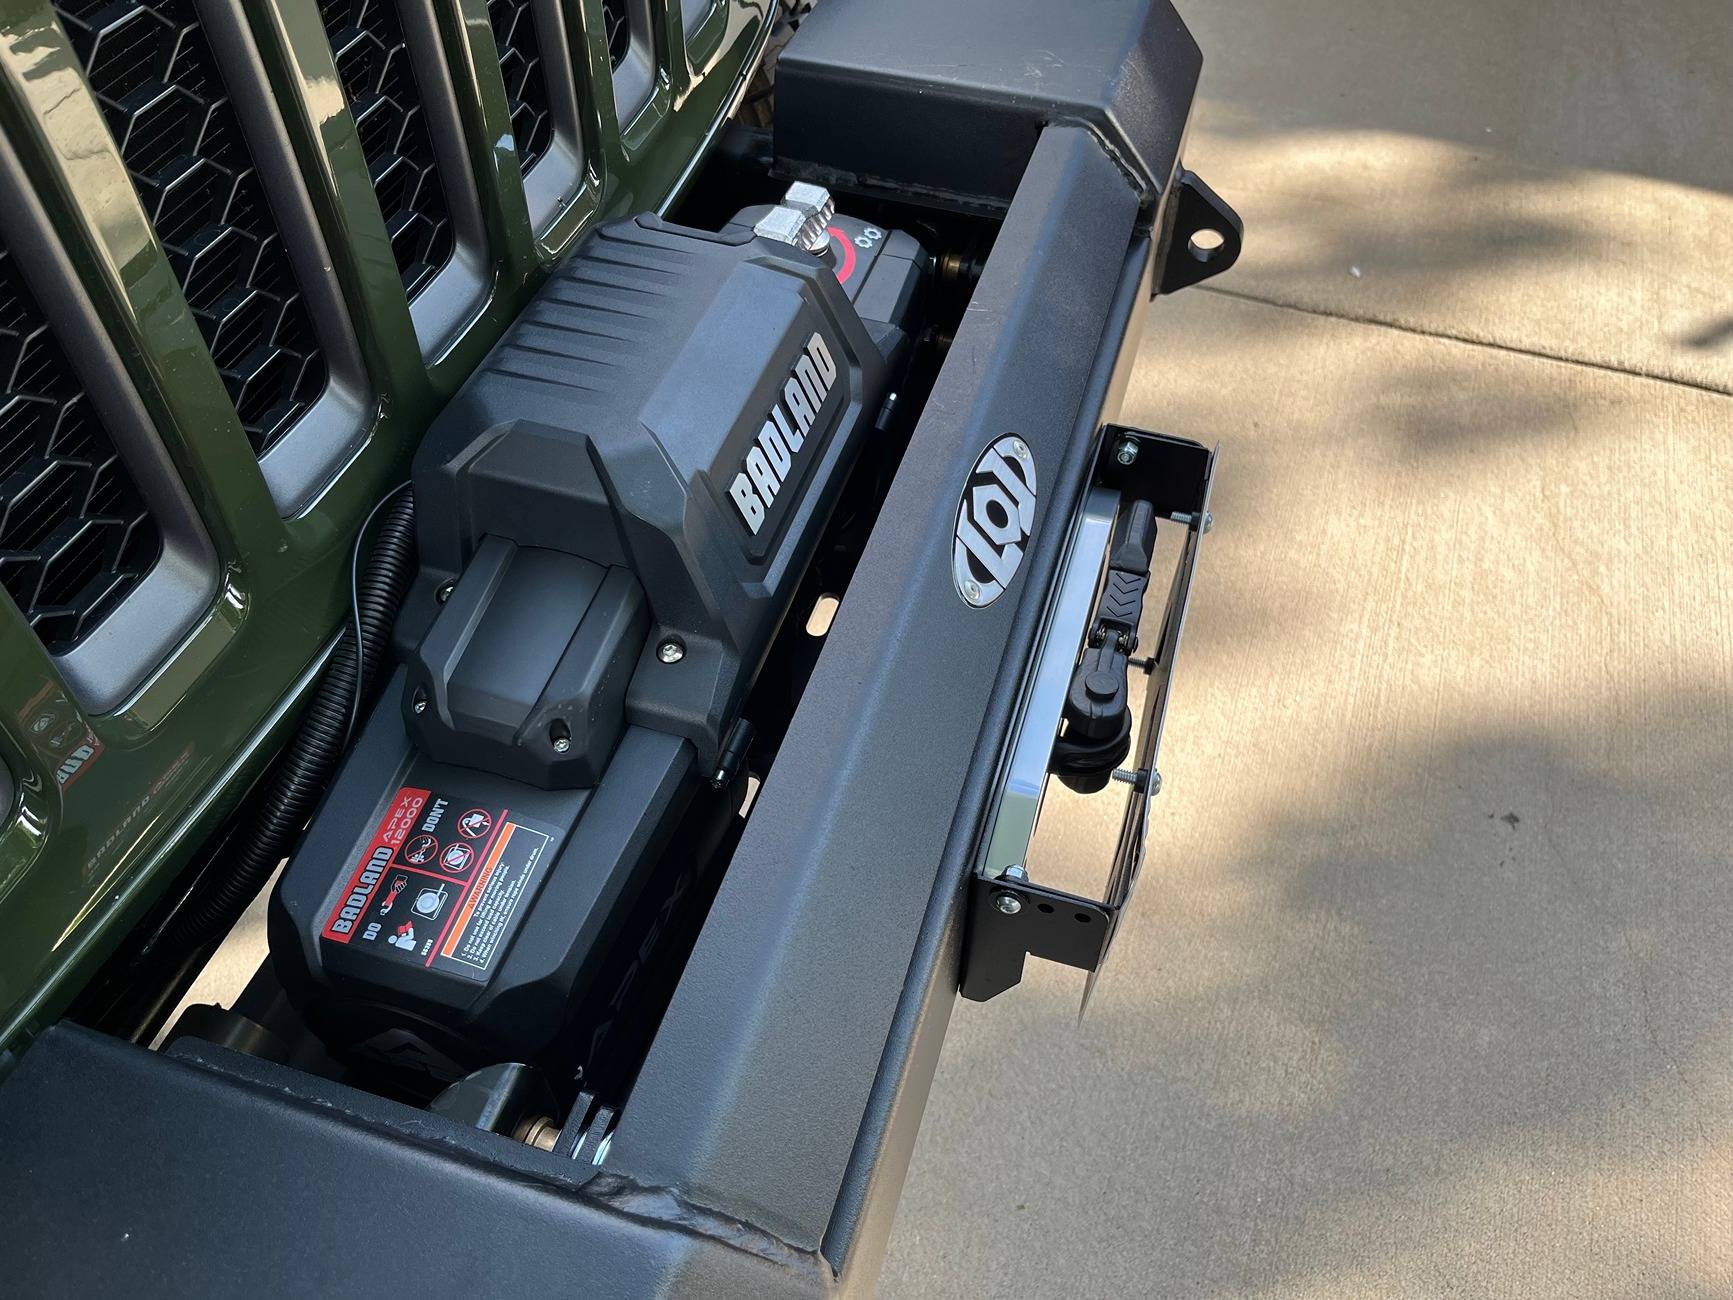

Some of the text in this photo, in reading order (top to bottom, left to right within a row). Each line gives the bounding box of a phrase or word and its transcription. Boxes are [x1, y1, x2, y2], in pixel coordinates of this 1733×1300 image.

[729, 331, 837, 536] BADLAND
[391, 797, 423, 845] 12000
[422, 798, 449, 833] DON'T
[331, 794, 412, 934] BADLAND APEX
[469, 865, 493, 903] WARNING
[362, 922, 382, 941] DO
